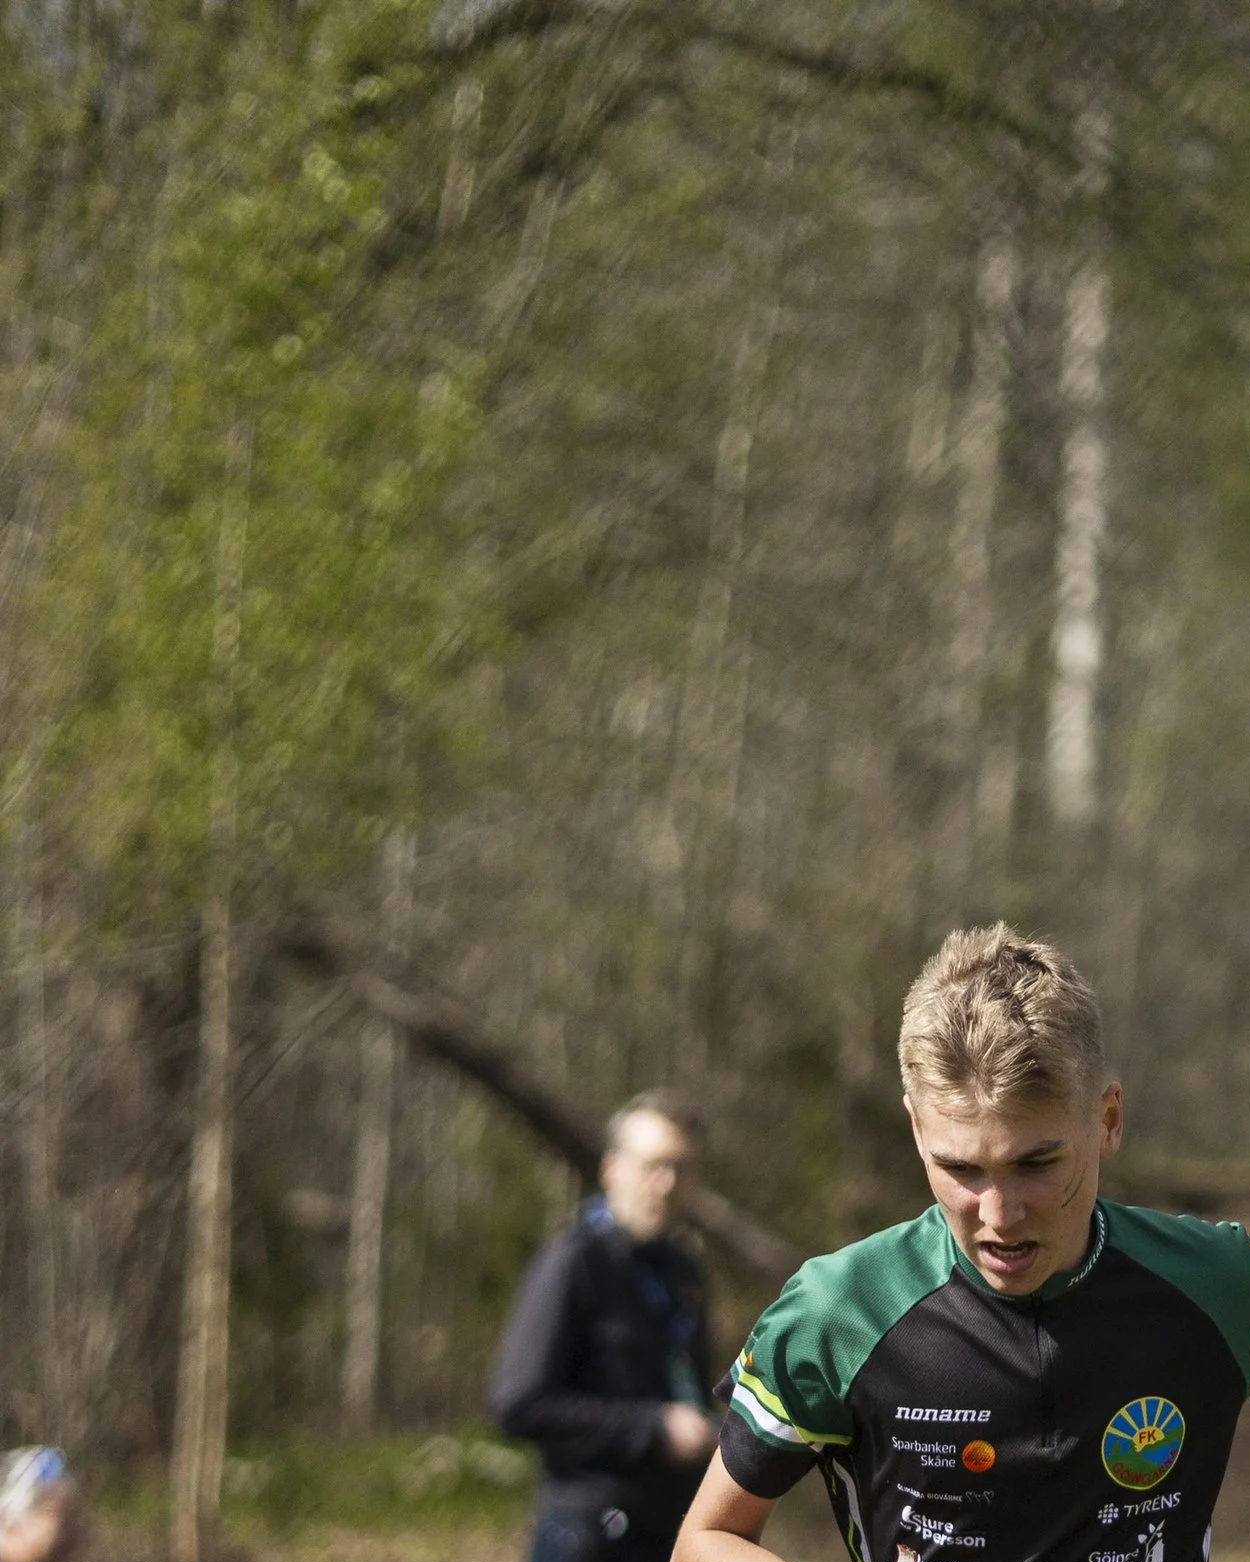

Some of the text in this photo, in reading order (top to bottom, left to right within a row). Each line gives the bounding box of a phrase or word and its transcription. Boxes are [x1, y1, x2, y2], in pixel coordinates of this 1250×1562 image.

[894, 1406, 991, 1422] noname
[1138, 1429, 1157, 1444] FK
[891, 1436, 957, 1454] Sparbanken
[920, 1454, 956, 1468] Skåne
